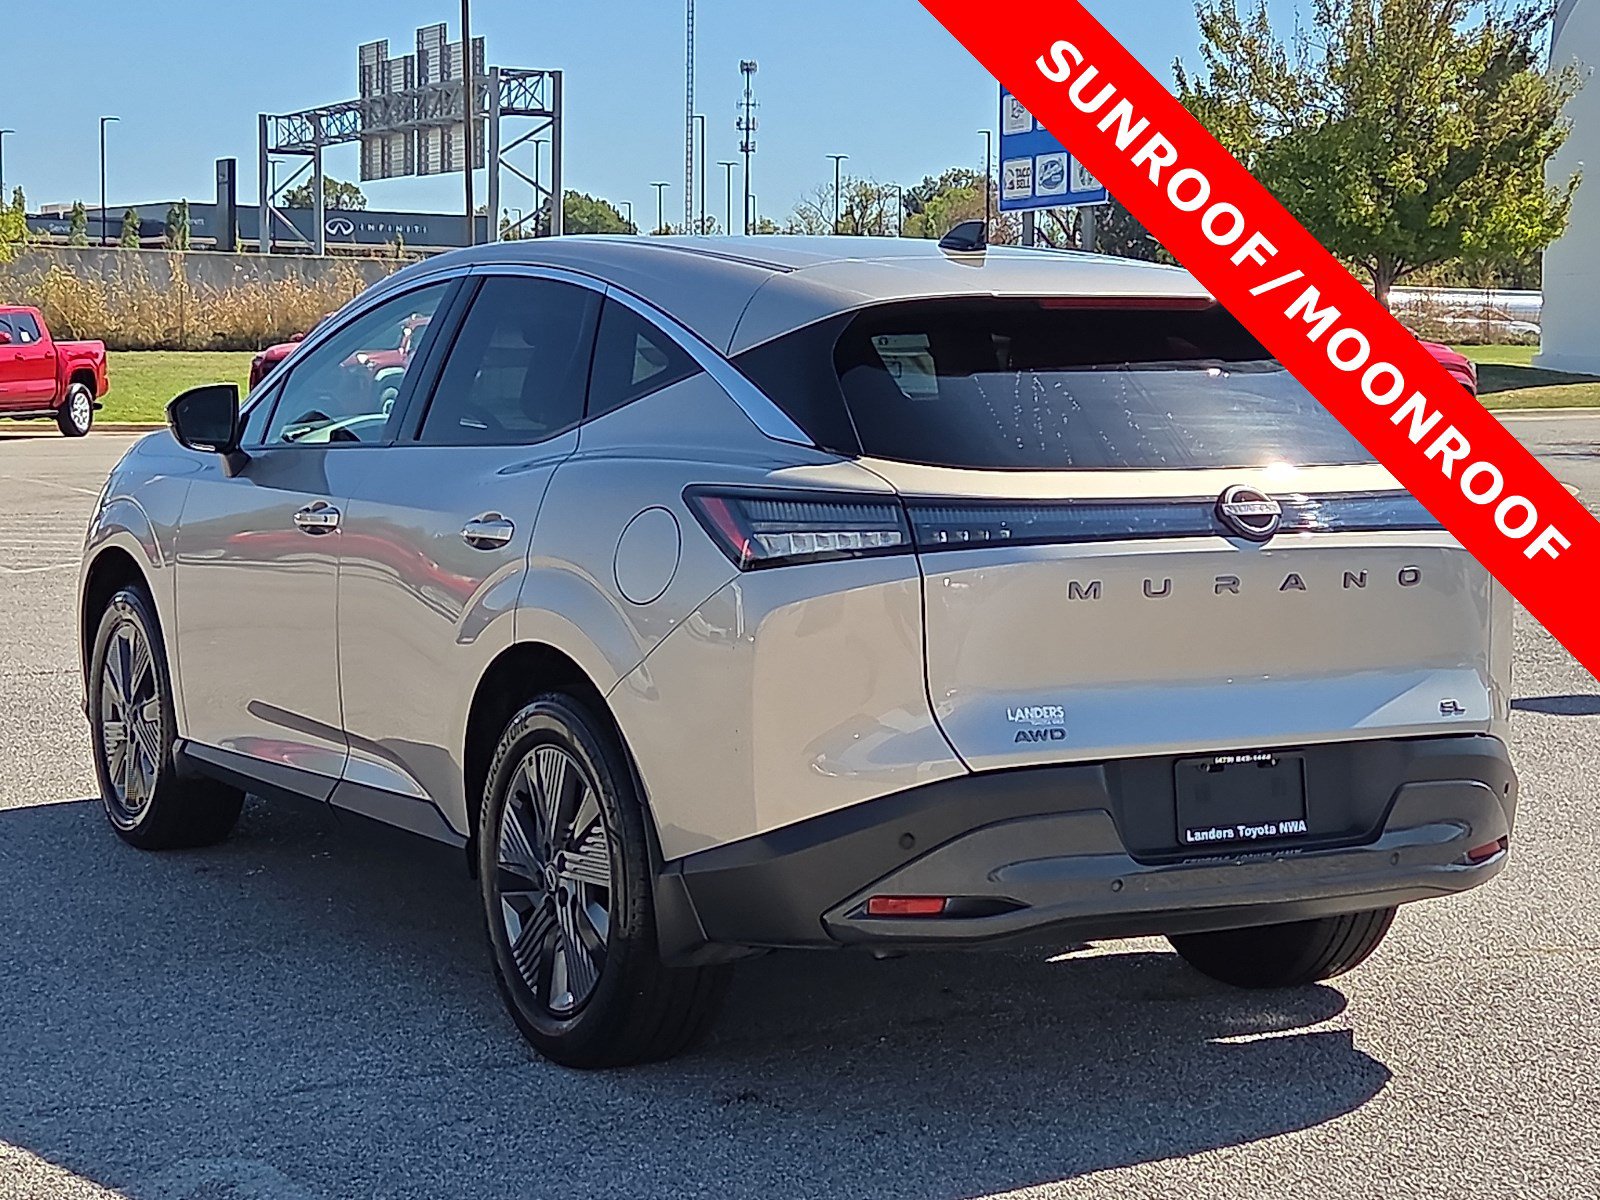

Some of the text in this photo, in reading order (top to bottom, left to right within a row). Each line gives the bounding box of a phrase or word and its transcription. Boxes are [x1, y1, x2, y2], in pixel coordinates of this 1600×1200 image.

[359, 223, 427, 234] INFINITI
[1068, 566, 1421, 600] MURANO
[1006, 706, 1064, 721] LANDERS
[1014, 728, 1066, 743] AWD
[1186, 819, 1307, 842] Landers Toyota NWA
